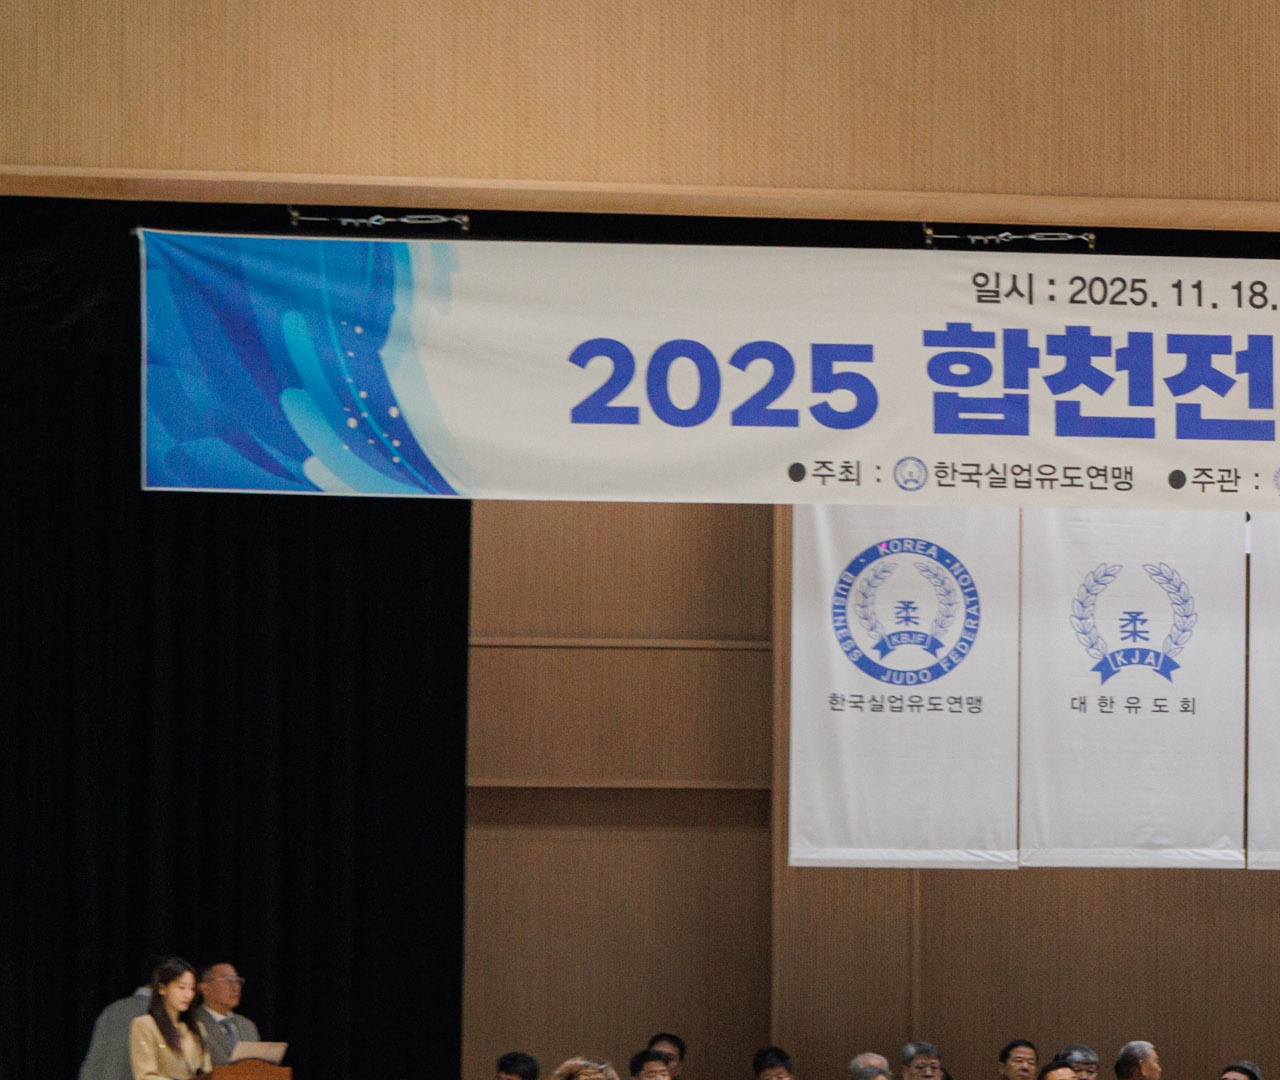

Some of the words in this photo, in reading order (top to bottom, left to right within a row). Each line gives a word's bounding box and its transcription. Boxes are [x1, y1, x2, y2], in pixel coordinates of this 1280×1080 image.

[972, 271, 1034, 306] 일시
[1068, 275, 1158, 308] 2025.
[1171, 279, 1218, 310] 11.
[569, 337, 878, 430] 2025
[934, 461, 1133, 492] 한국실업유도연맹
[1119, 611, 1150, 642] 柔
[1114, 649, 1157, 666] KJA
[881, 669, 932, 685] JUDO
[829, 693, 983, 715] 한국실업유도연맹
